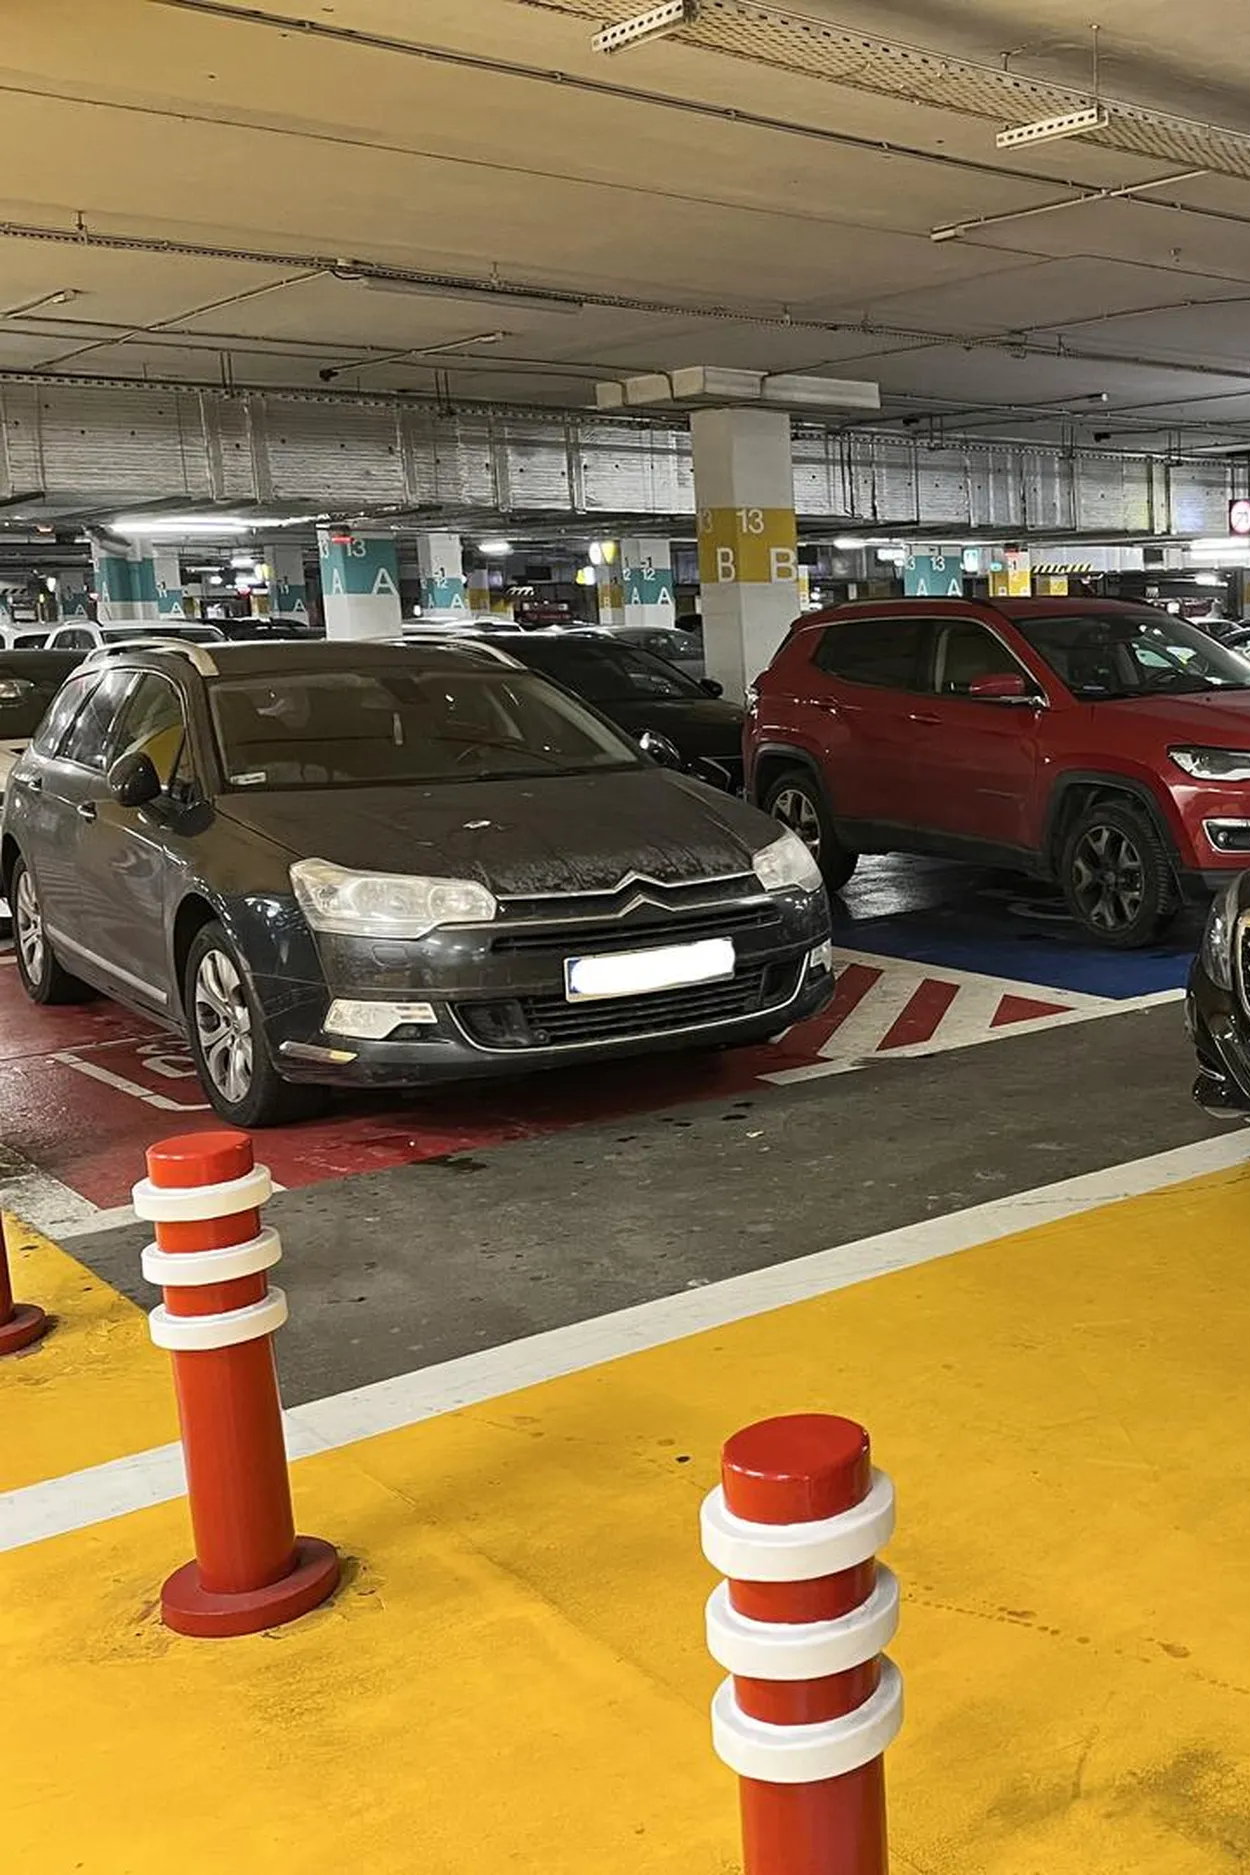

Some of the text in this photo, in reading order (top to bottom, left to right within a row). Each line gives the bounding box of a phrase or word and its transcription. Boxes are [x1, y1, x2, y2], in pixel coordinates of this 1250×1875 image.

[736, 508, 765, 534] 13
[346, 538, 367, 557] 13
[717, 547, 736, 583] B
[769, 547, 798, 584] B
[930, 556, 946, 572] 13
[332, 568, 344, 595] A
[371, 568, 400, 595] A
[642, 567, 656, 581] 12
[631, 586, 641, 605] A
[657, 586, 673, 605] A
[916, 578, 929, 596] A
[947, 578, 963, 597] A
[170, 602, 185, 618] A
[292, 599, 306, 612] A
[450, 593, 466, 609] A
[74, 604, 88, 618] A
